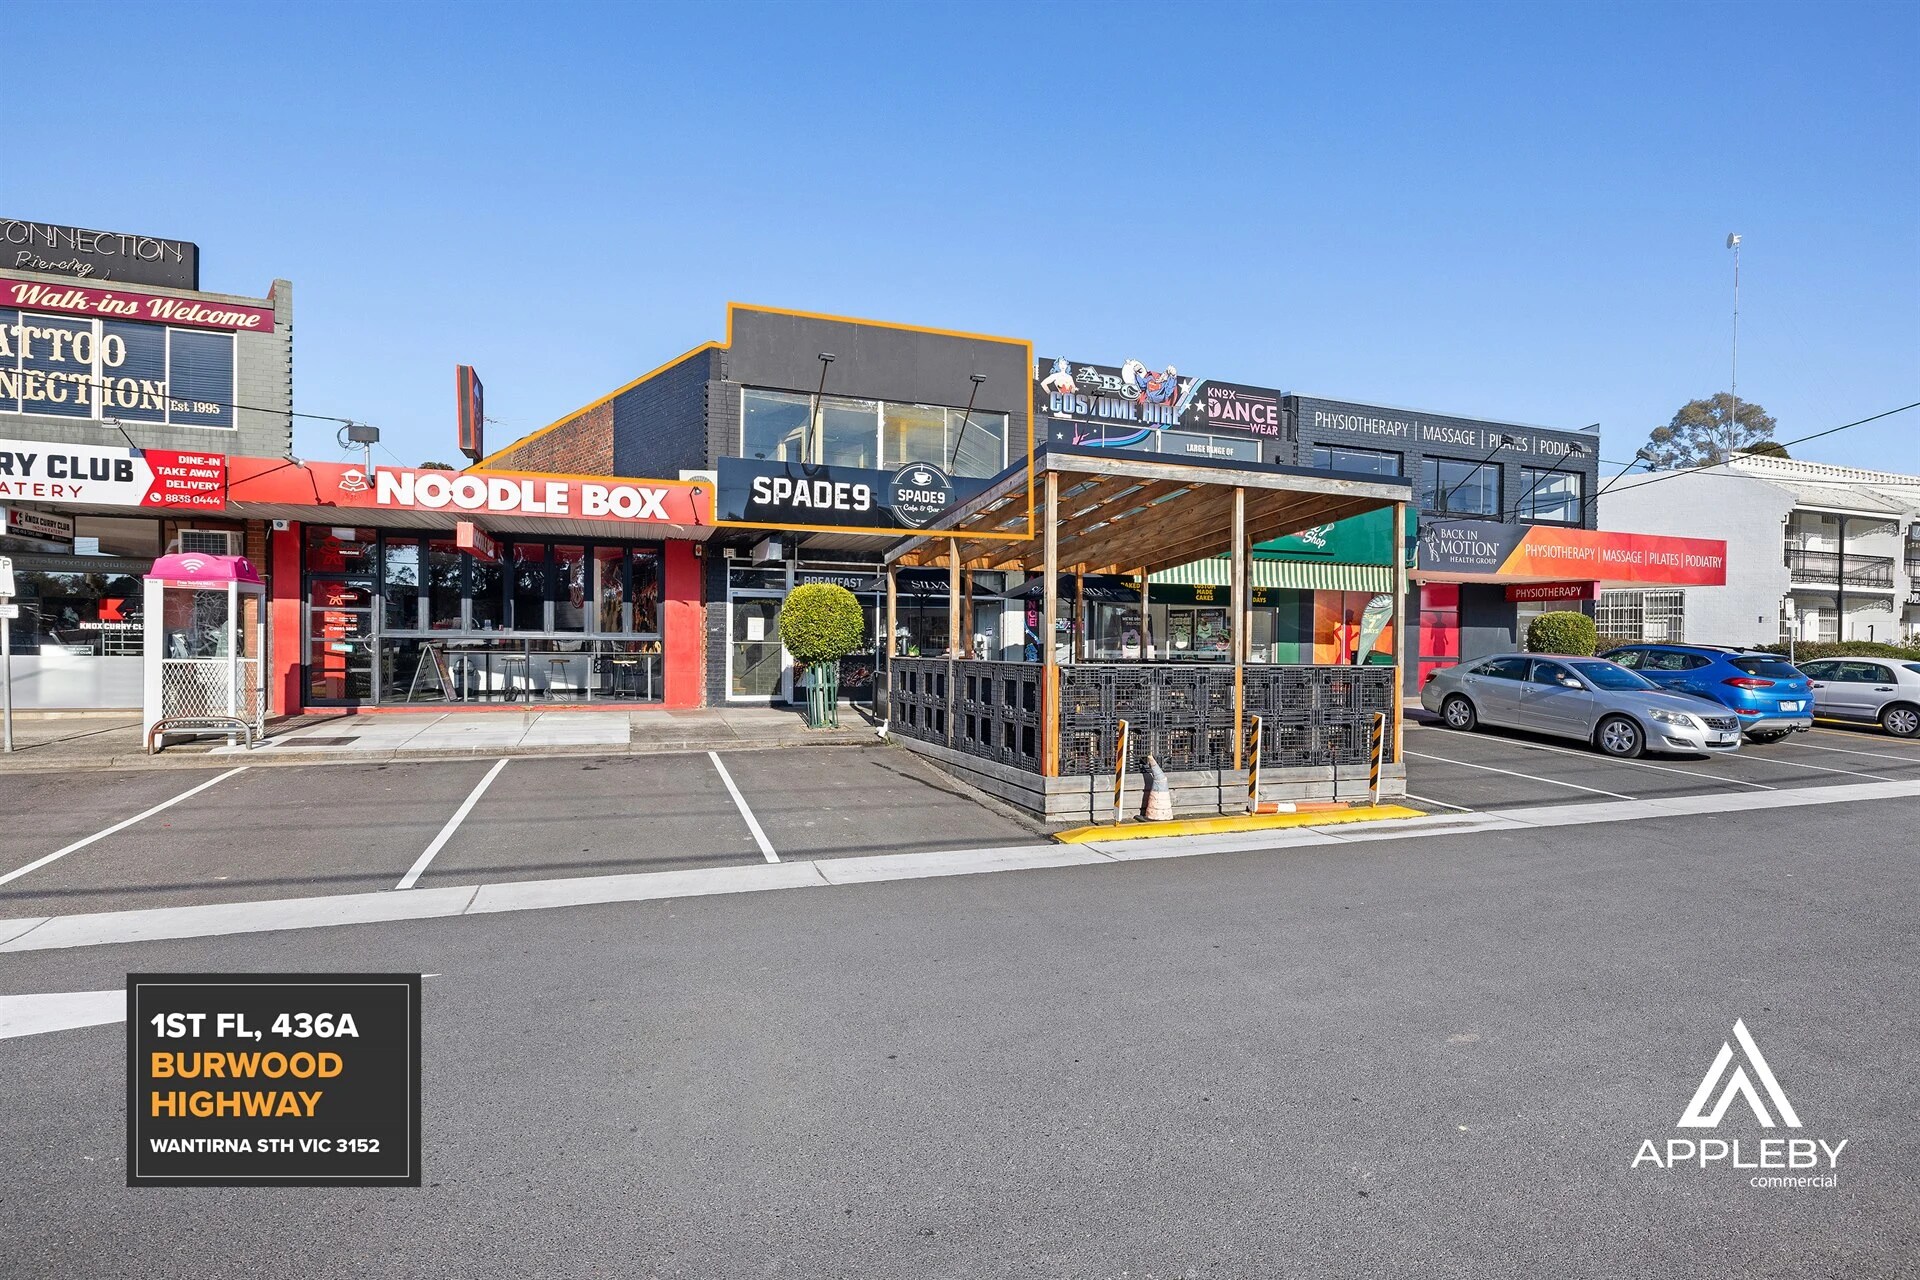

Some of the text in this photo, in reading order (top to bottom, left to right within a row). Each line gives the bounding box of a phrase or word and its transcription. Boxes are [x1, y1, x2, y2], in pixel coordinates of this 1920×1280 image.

[0, 219, 183, 262] ONNECTION
[11, 283, 261, 328] Walk-ins Welcome
[1207, 387, 1236, 400] KNOX
[170, 400, 220, 414] Est 1995
[1050, 391, 1180, 425] COSTUME HIRE
[1208, 398, 1278, 425] DANCE
[1250, 423, 1278, 435] WEAR
[1315, 411, 1409, 437] PHYSIOTHERAPY
[1423, 425, 1475, 446] MASSAGE
[1186, 444, 1205, 453] LARGE
[47, 454, 133, 482] CLUB
[178, 455, 221, 466] DINE-IN
[157, 466, 220, 478] TAKE AWAY
[166, 479, 220, 491] DELIVERY
[192, 495, 220, 505] 0444
[377, 470, 670, 520] NOODLE BOX
[752, 476, 870, 511] SPADE9
[898, 488, 946, 504] SPADE9
[926, 505, 940, 513] Bar
[1302, 531, 1326, 549] Shop
[1441, 528, 1478, 540] BACK IN
[1440, 540, 1497, 556] MOTION
[1524, 543, 1722, 569] PHYSIOTHERAPY MASSAGE PILATES PODIATRY
[1515, 586, 1582, 598] PHYSIOTHERAPY
